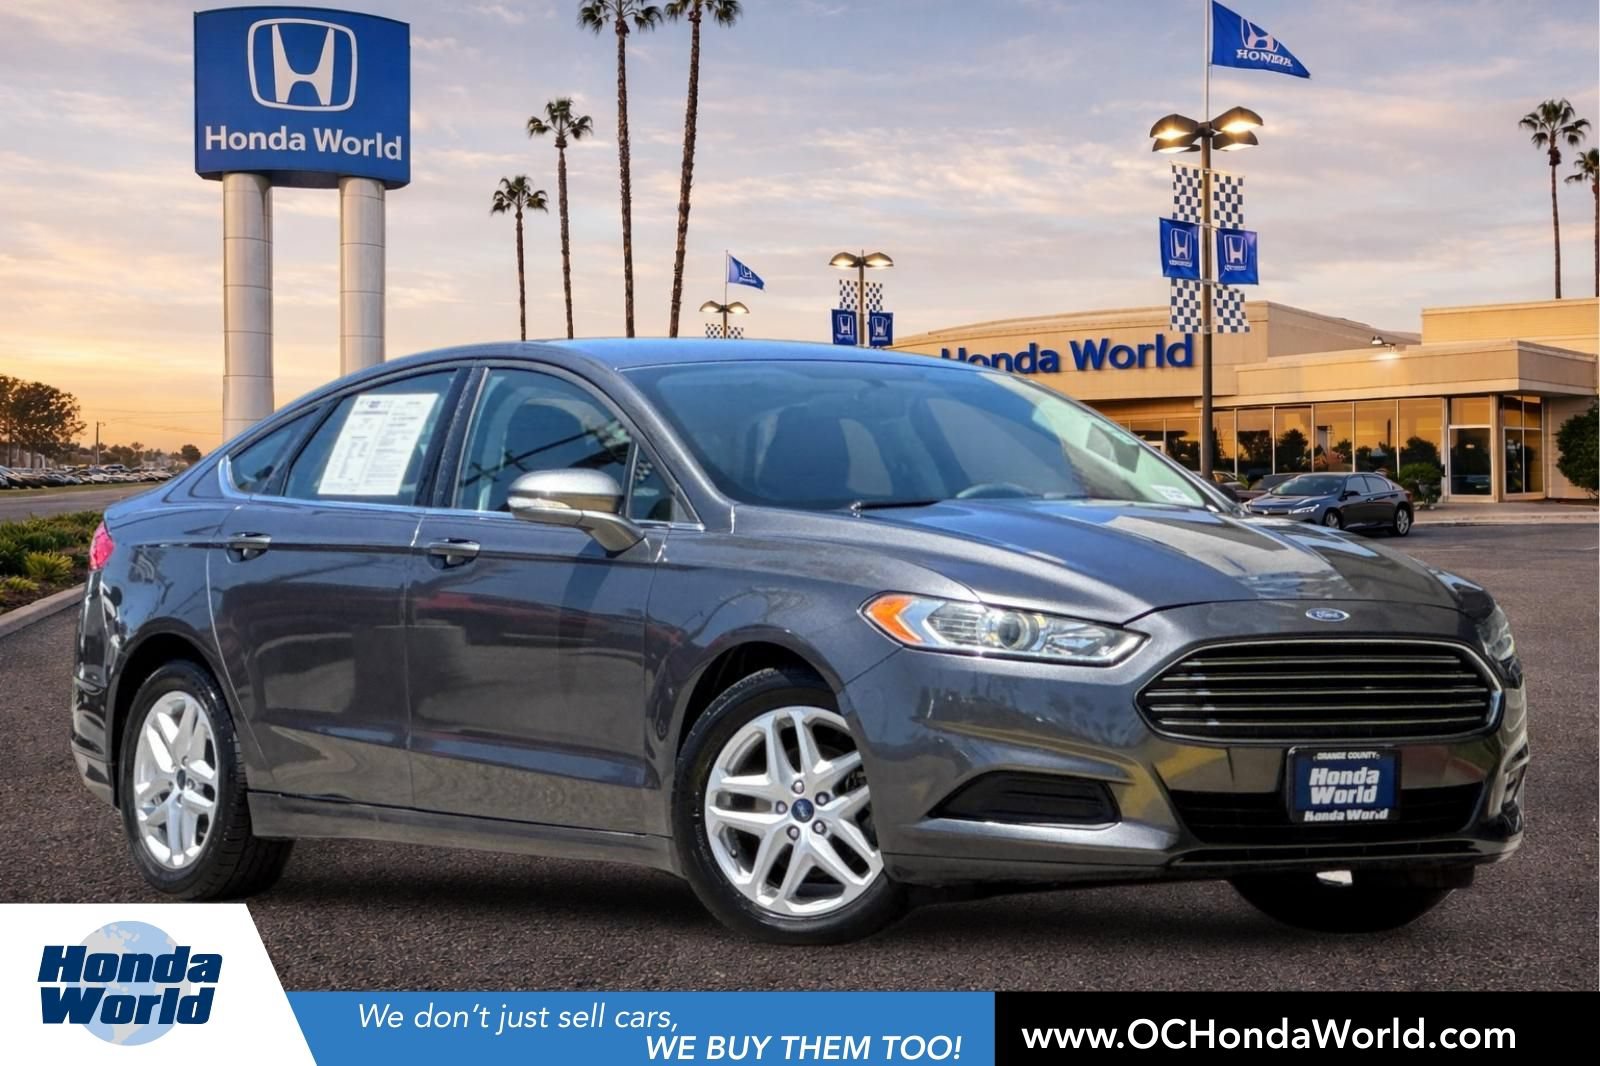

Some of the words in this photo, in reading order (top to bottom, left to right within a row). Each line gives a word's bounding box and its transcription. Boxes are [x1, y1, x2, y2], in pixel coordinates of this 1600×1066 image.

[205, 125, 306, 151] Honda
[313, 127, 402, 161] World
[1069, 333, 1194, 371] World
[1347, 752, 1377, 760] COUNTY
[1309, 767, 1380, 786] Honda
[1311, 785, 1378, 805] World
[1304, 810, 1345, 821] Honda
[1346, 808, 1389, 821] World
